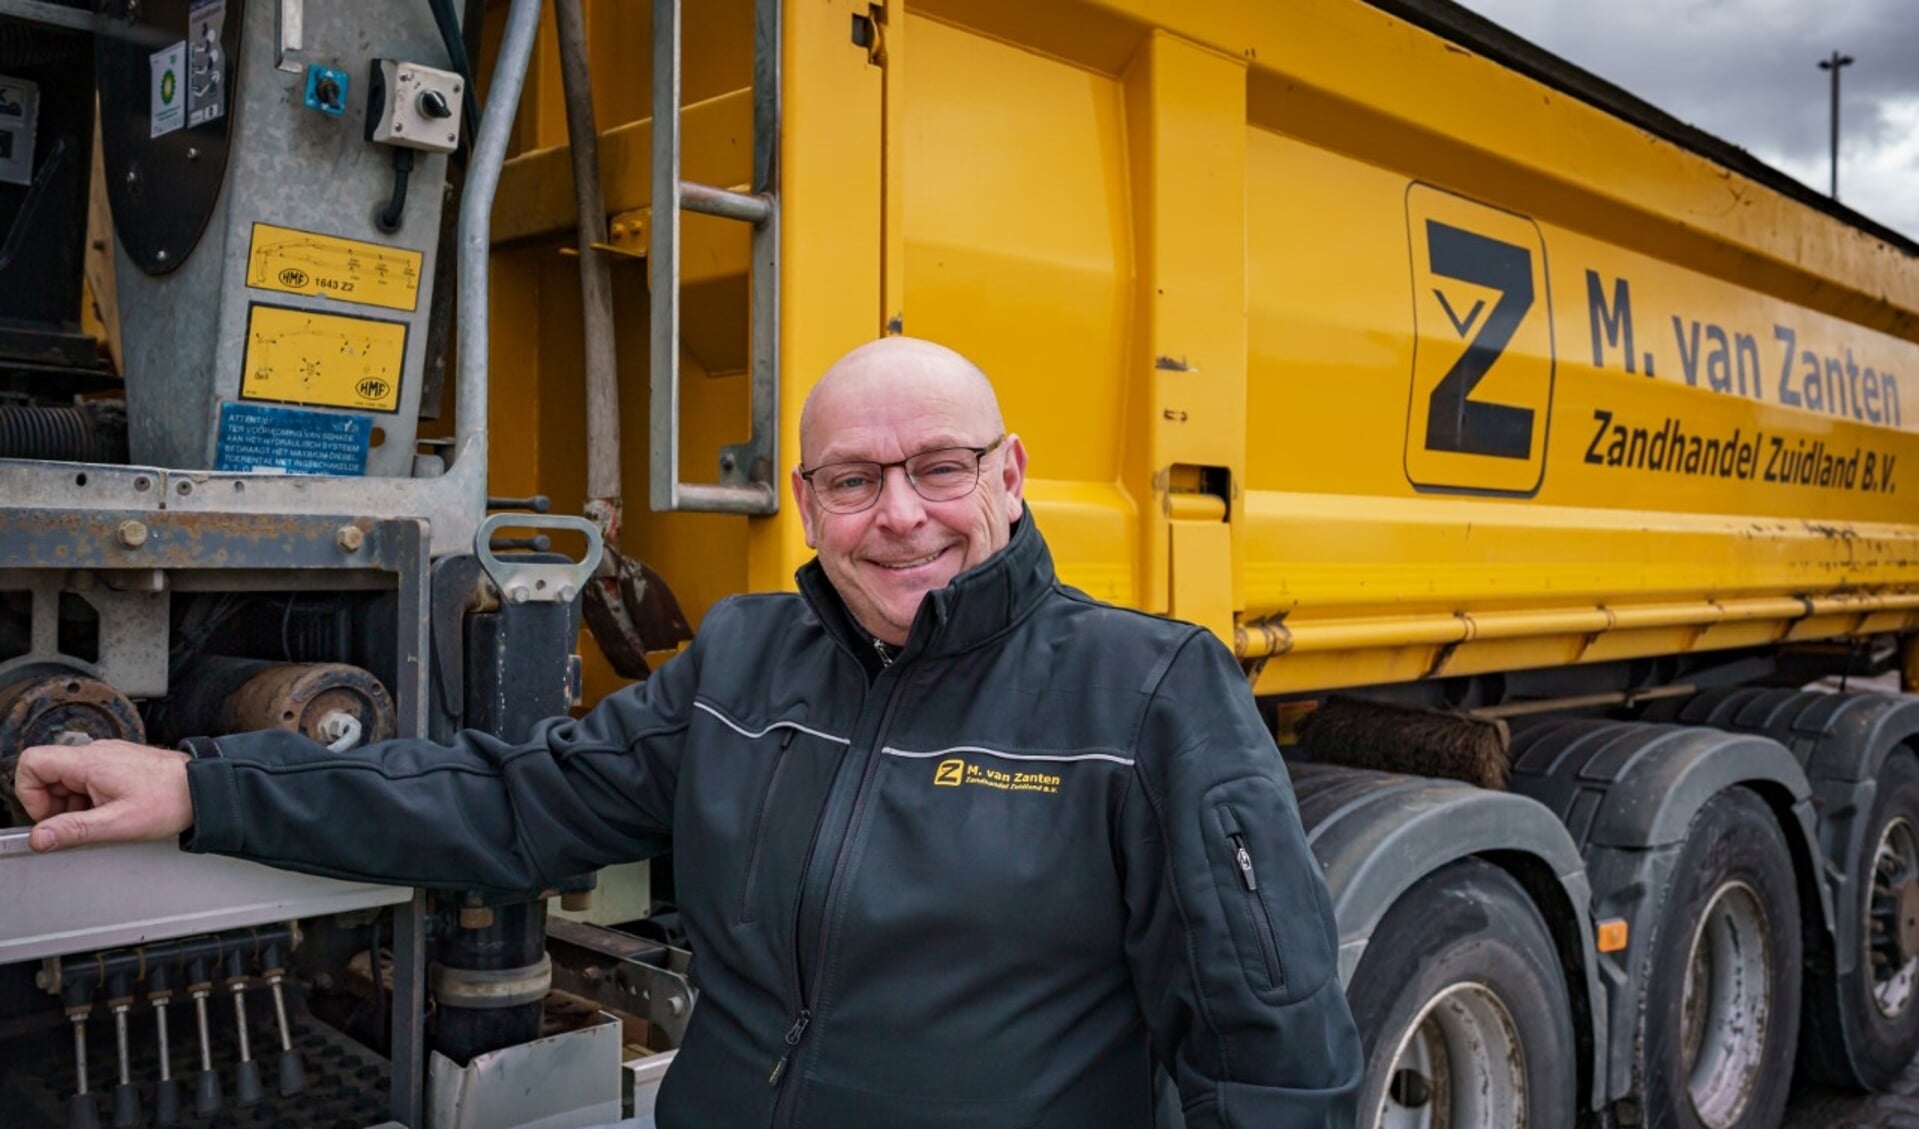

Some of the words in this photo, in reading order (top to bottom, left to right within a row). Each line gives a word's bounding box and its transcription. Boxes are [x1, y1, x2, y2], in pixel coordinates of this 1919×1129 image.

[315, 278, 338, 290] 1643
[341, 280, 354, 292] Z2
[1425, 219, 1535, 461] Z
[1585, 268, 1655, 378] M.
[1672, 314, 1762, 399] van
[1773, 324, 1900, 428] Zanten
[359, 380, 386, 397] HMF
[1584, 410, 1763, 481] Zandhandel
[1764, 436, 1859, 491] Zuidland
[1861, 450, 1897, 494] B.V.
[965, 776, 1010, 789] Zandhandel
[966, 764, 982, 776] M.
[986, 769, 1011, 782] van
[1013, 772, 1061, 785] Zanten
